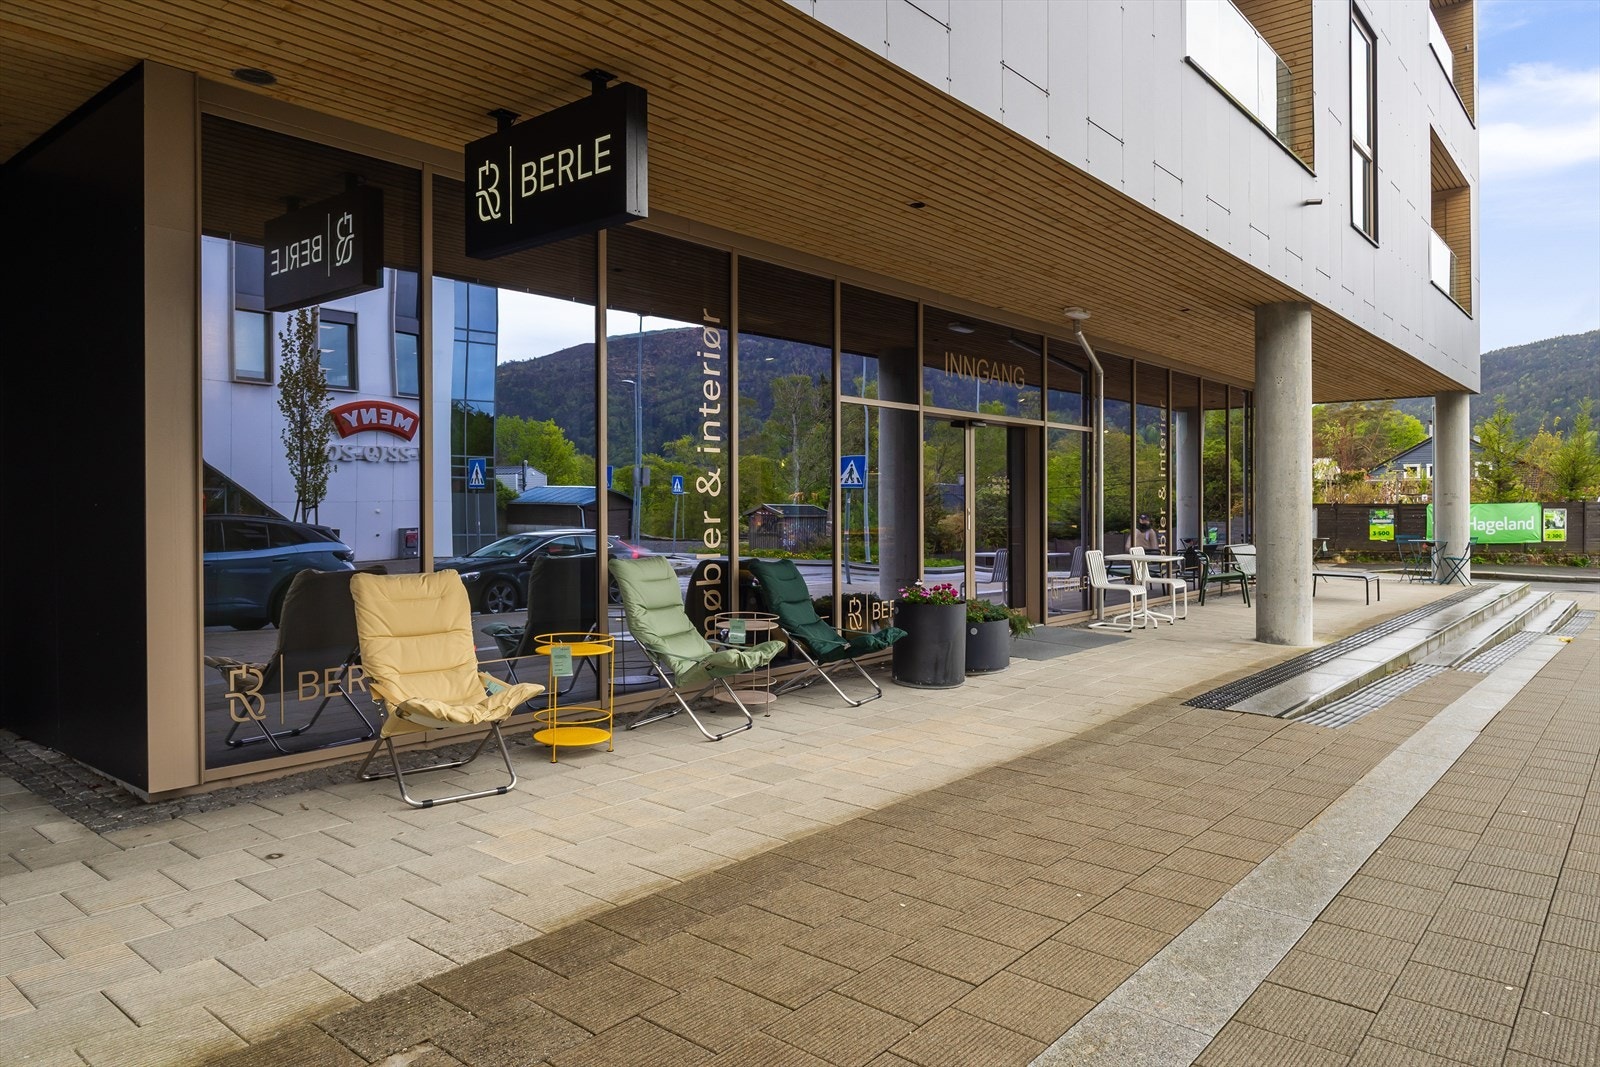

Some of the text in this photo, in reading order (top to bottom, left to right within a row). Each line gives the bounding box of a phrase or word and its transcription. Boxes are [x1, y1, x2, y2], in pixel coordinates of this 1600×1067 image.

[521, 133, 612, 198] BERLE
[945, 351, 1025, 390] INNGANG
[694, 308, 722, 653] møbler & interiør
[1470, 516, 1535, 535] Hageland
